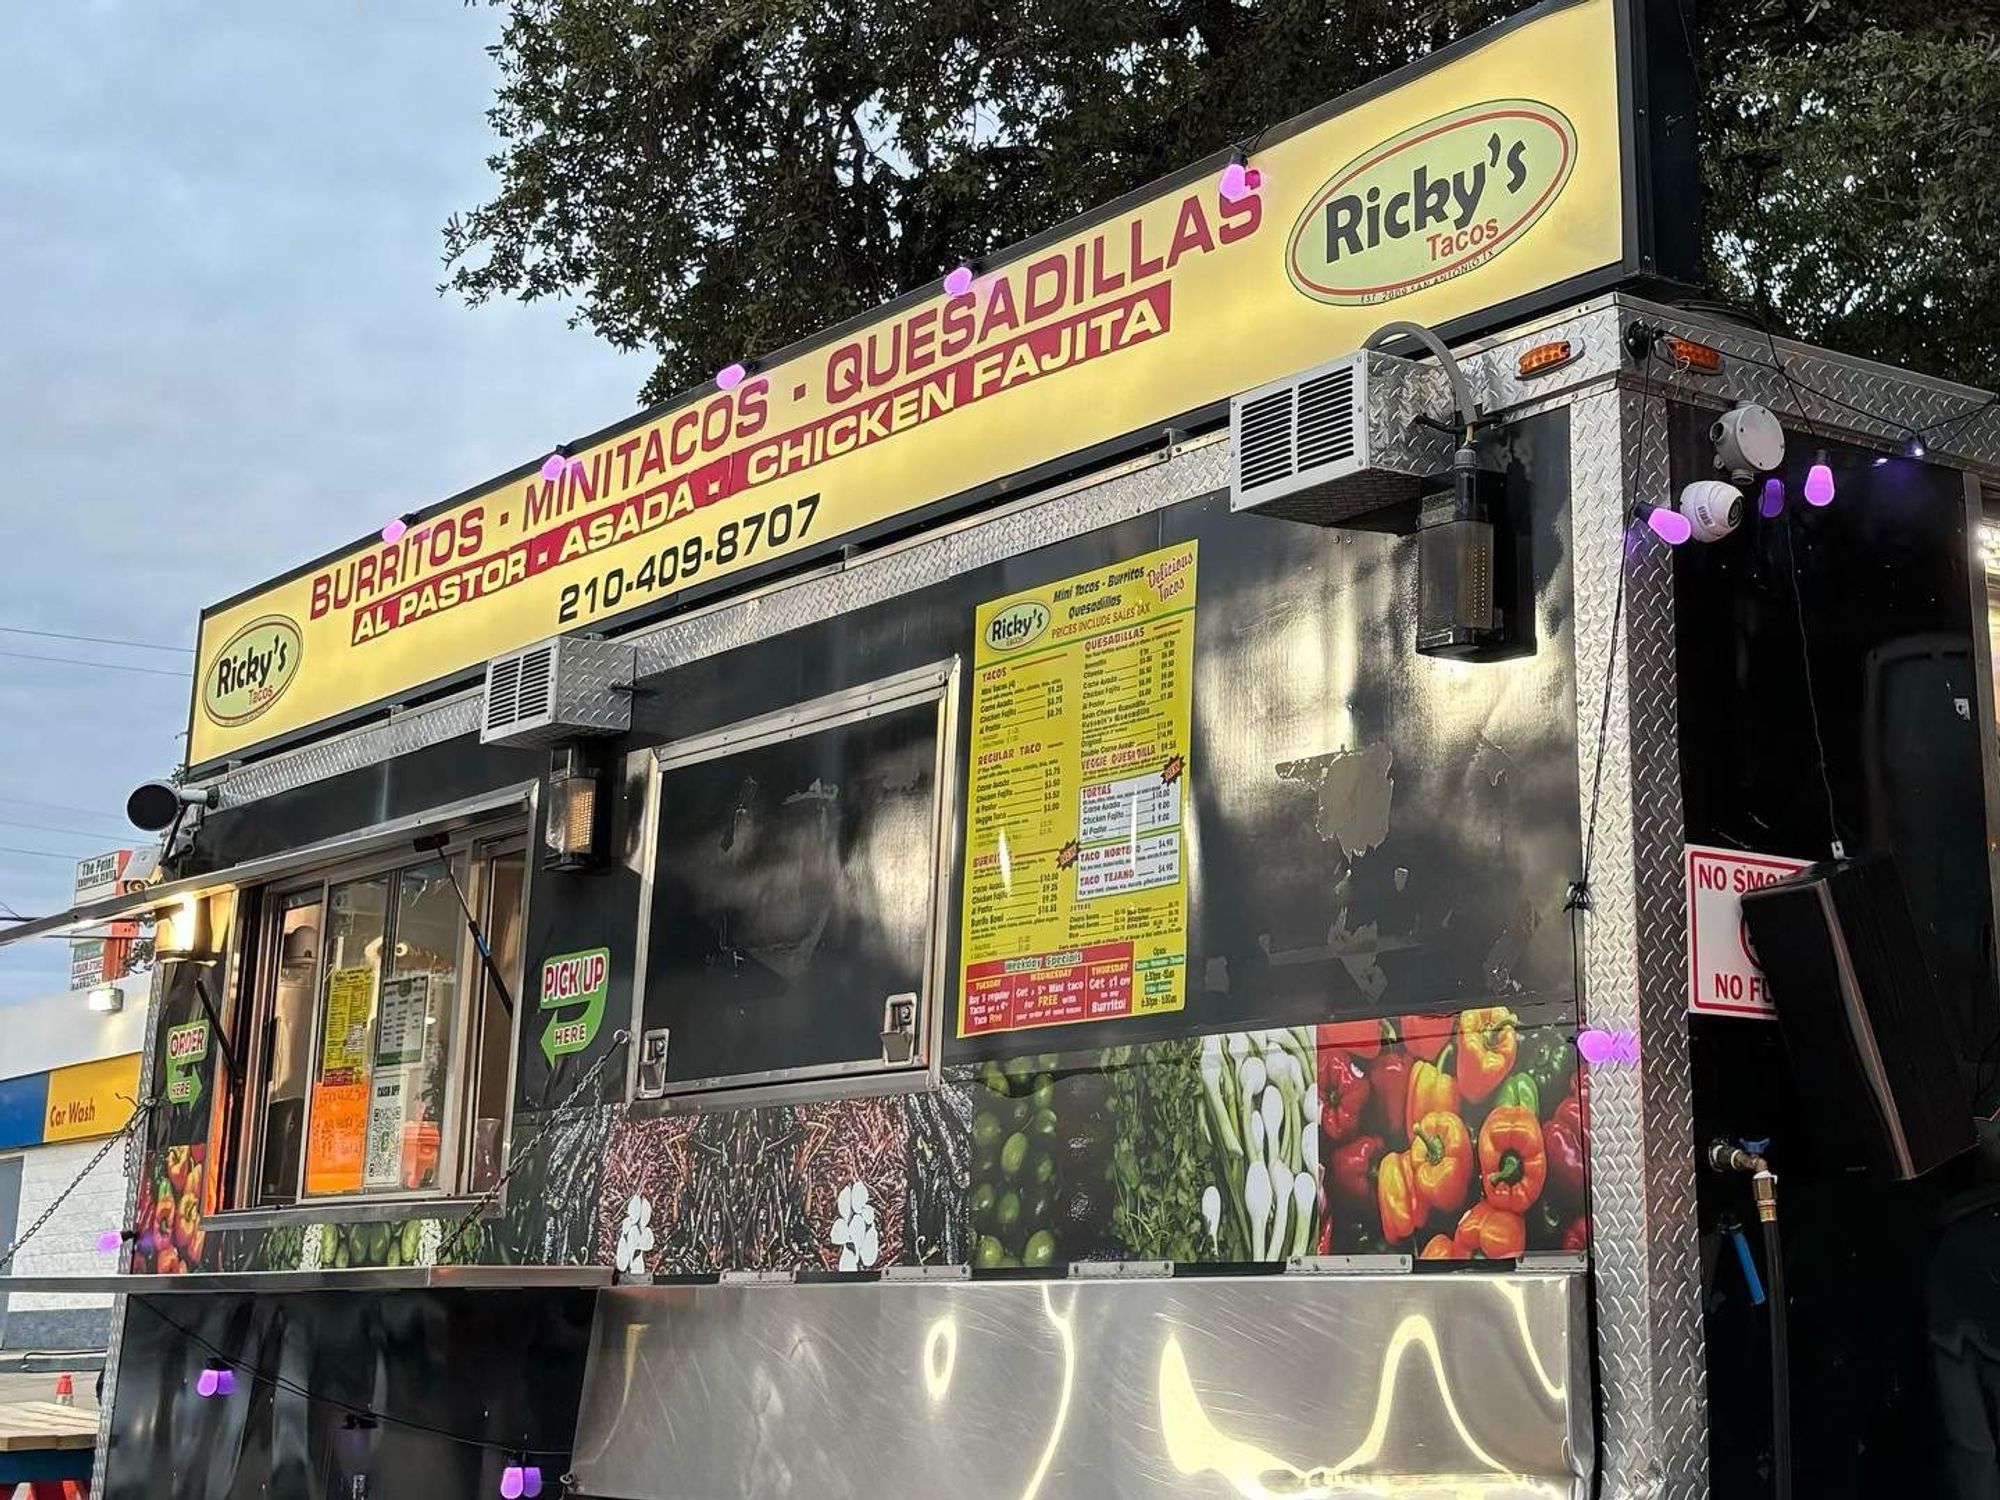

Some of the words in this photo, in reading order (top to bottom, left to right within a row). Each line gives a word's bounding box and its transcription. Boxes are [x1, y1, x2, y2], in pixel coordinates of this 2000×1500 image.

[1326, 132, 1527, 264] Ricky's
[1426, 217, 1499, 262] Tacos
[310, 506, 485, 621] BURRITOS
[522, 378, 768, 533] MINITACOS
[827, 169, 1262, 404] QUESADILLAS
[354, 606, 389, 643] AL
[398, 548, 527, 627] PASTOR
[559, 481, 695, 562] ASADA
[747, 372, 957, 486] CHICKEN
[973, 298, 1163, 399] FAJITA
[558, 493, 821, 625] 210-409-8707
[1146, 552, 1193, 589] Delicious
[1053, 586, 1074, 603] Mini
[1075, 580, 1099, 596] Tacos
[1107, 566, 1145, 588] Burritos
[1157, 576, 1185, 602] Tacos
[1068, 594, 1122, 620] Quesadillas
[991, 609, 1044, 642] Ricky's
[1051, 625, 1077, 639] PRICES
[1077, 616, 1111, 632] INCLUDE
[1112, 608, 1135, 624] SALES
[1136, 602, 1151, 616] TAX
[1084, 627, 1145, 651] QUESADILLAS
[217, 634, 288, 698] Ricky's
[982, 667, 1007, 682] TACOS
[248, 684, 273, 705] Tacos
[977, 748, 1015, 766] REGULAR
[1020, 742, 1041, 756] TACO
[1081, 755, 1107, 770] VEGGIE
[1111, 745, 1156, 764] QUESADILLA
[1082, 784, 1111, 799] TORTAS
[82, 863, 94, 876] The
[95, 856, 115, 873] Point
[1080, 850, 1100, 862] TACO
[1104, 844, 1141, 858] NORTEO
[1080, 874, 1100, 886] TACO
[1104, 869, 1135, 882] TEJANO
[1698, 864, 1728, 891] NO
[1005, 957, 1042, 972] Weekday
[1045, 951, 1082, 967] Specials
[545, 961, 580, 999] PICK
[583, 956, 605, 992] UP
[975, 979, 1001, 991] TUESDAY
[1030, 969, 1073, 981] WEDNESDAY
[1091, 963, 1129, 976] THURSDAY
[1089, 977, 1105, 990] Get
[1715, 973, 1743, 1000] NO
[1038, 994, 1058, 1007] FREE
[171, 1027, 205, 1057] ORDER
[555, 1024, 586, 1045] HERE
[172, 1081, 190, 1096] HERE
[50, 1104, 66, 1128] Car
[68, 1097, 96, 1124] Wash
